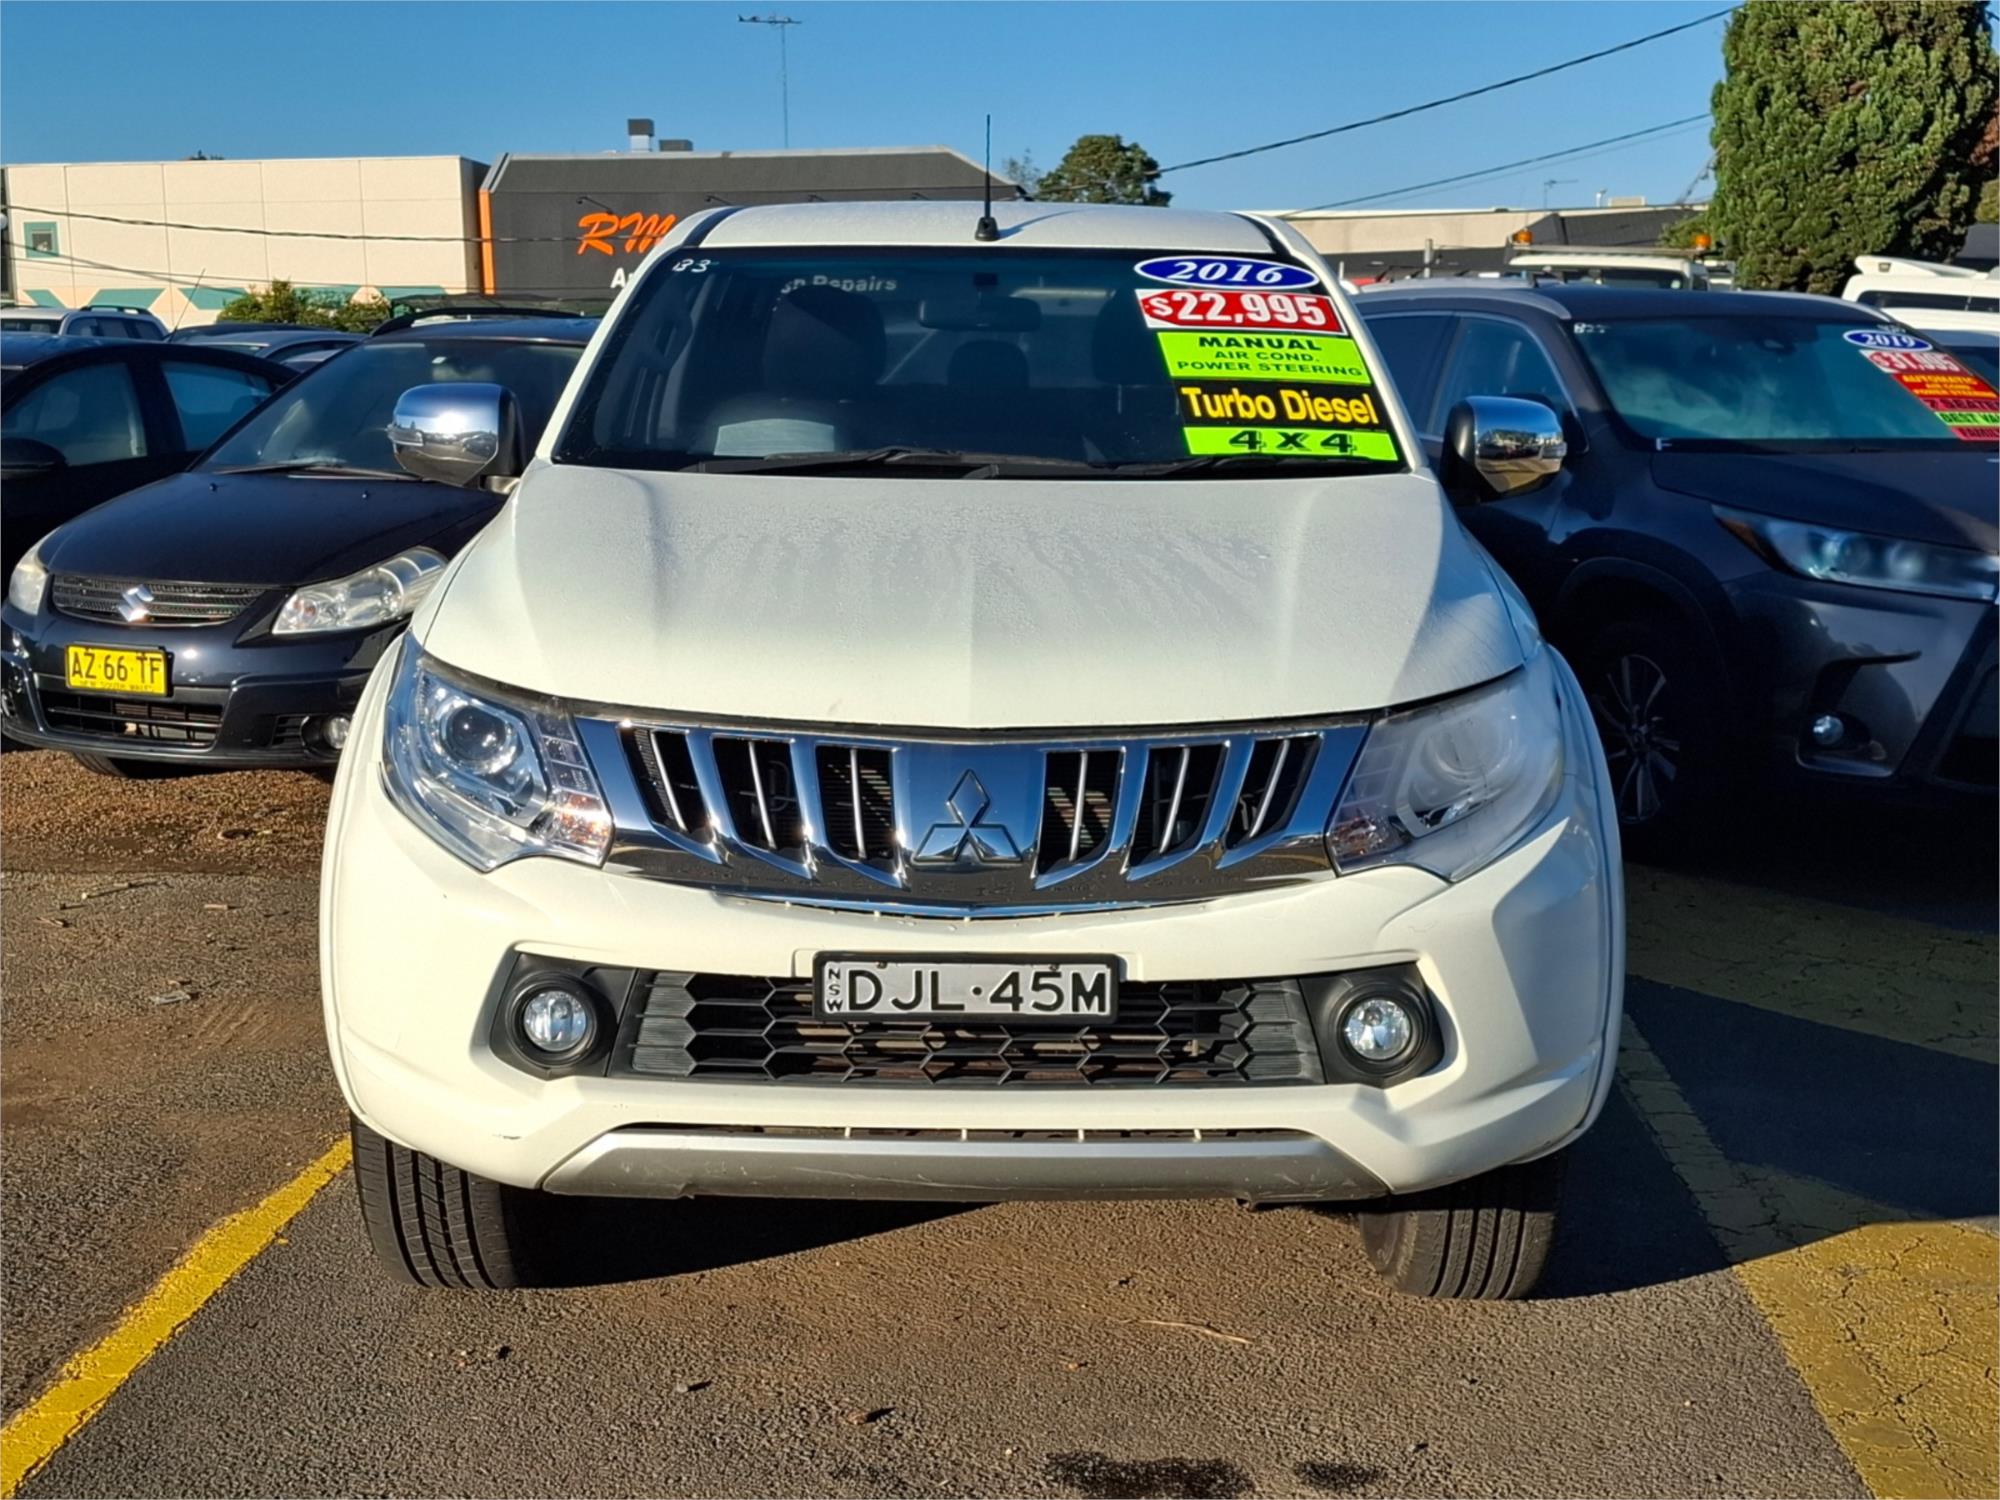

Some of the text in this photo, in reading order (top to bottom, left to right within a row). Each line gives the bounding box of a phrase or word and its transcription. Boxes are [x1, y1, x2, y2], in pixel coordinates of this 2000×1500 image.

[1166, 260, 1286, 284] 2016
[1149, 291, 1327, 327] $22,995
[1199, 336, 1323, 351] MANUAL
[1861, 333, 1916, 348] 2019
[1214, 350, 1320, 363] AIR COND.
[1178, 360, 1363, 377] POWER STEERING
[1181, 387, 1379, 424] Turbo Diesel
